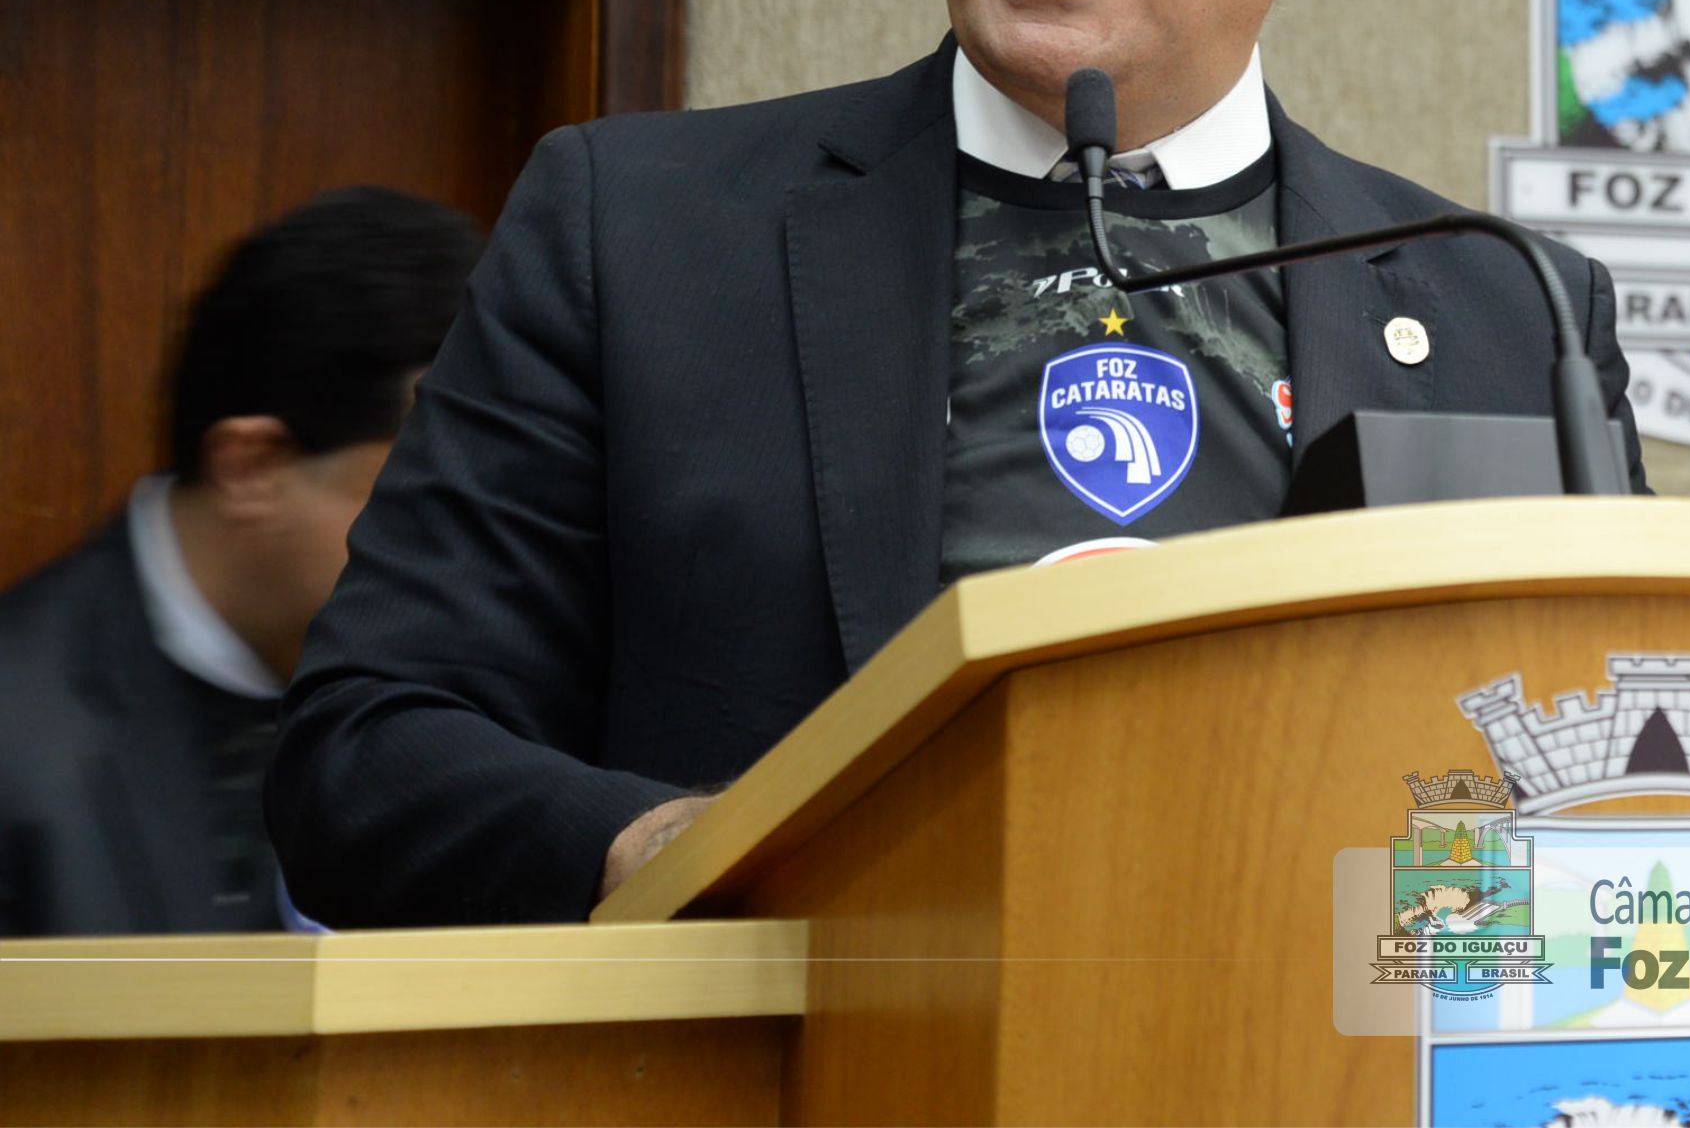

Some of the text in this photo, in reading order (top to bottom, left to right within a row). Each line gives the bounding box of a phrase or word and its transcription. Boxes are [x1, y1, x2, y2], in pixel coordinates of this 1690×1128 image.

[1568, 171, 1683, 214] FOZ
[1096, 357, 1138, 379] FOZ
[1051, 379, 1186, 411] CATARATAS
